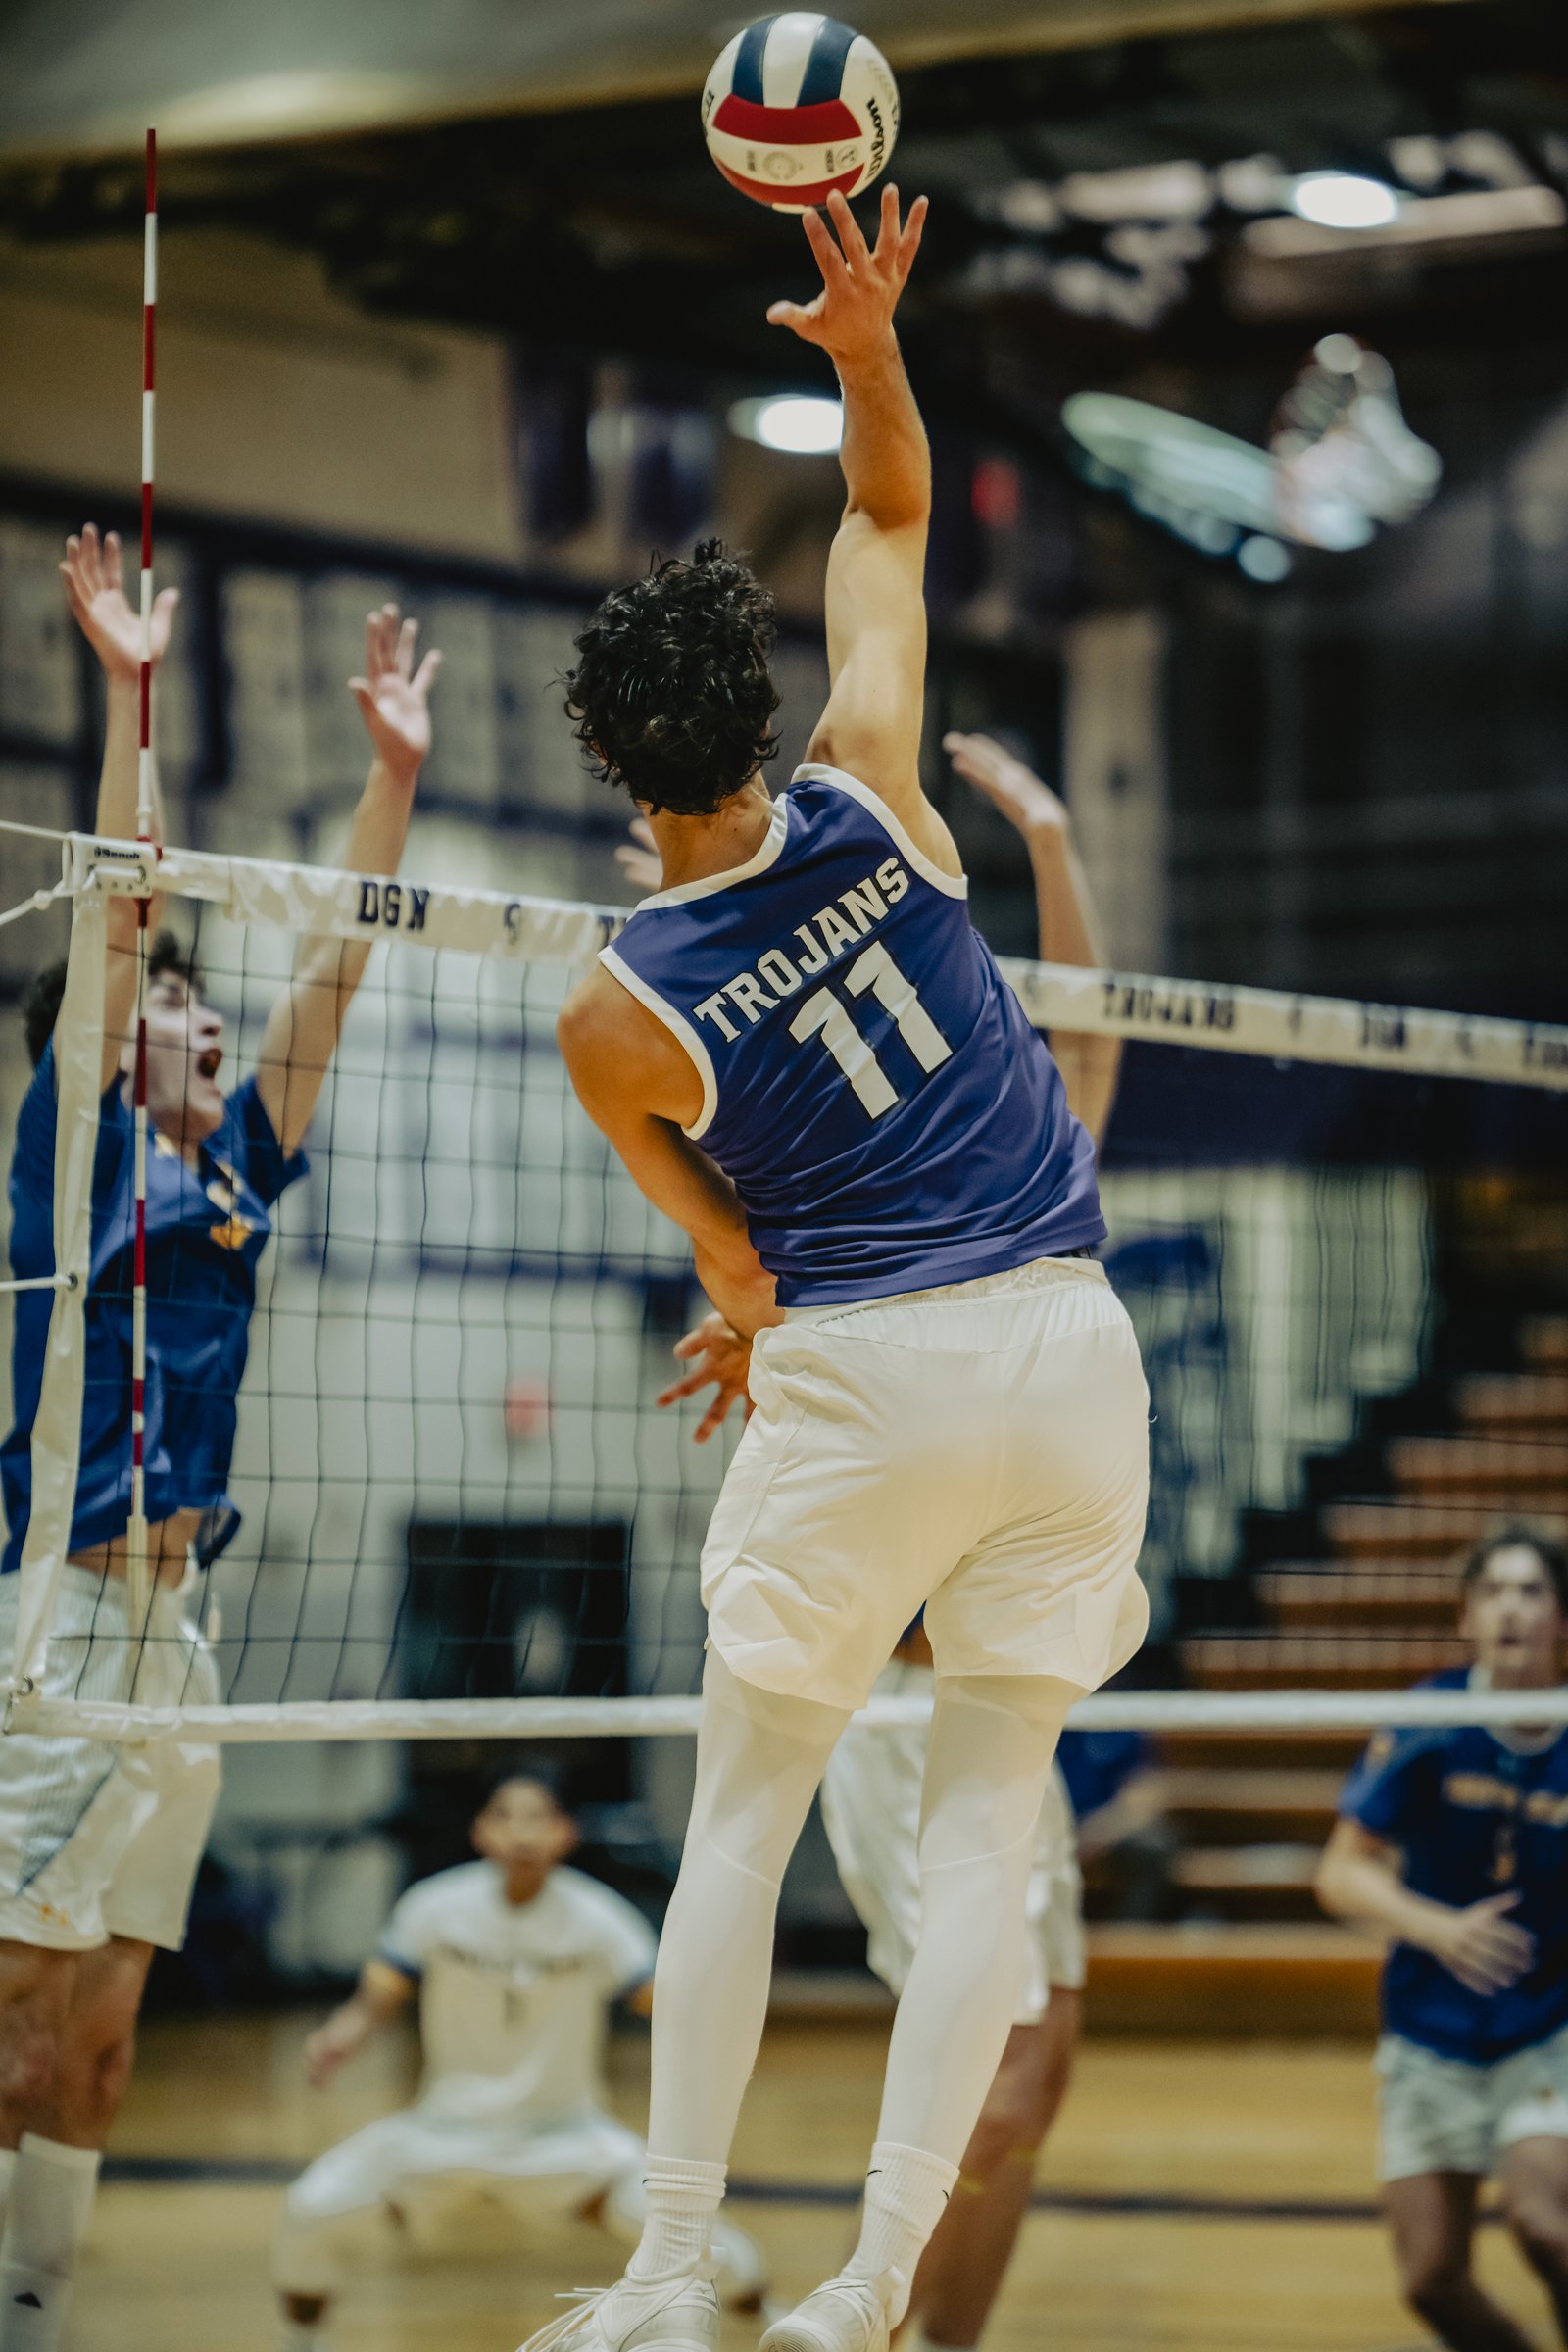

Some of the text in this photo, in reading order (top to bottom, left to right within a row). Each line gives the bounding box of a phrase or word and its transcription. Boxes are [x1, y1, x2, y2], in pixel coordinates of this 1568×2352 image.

[866, 97, 885, 181] Wilson
[357, 880, 430, 931] DGN
[692, 856, 911, 1044] TROJANS
[788, 940, 955, 1121] 11
